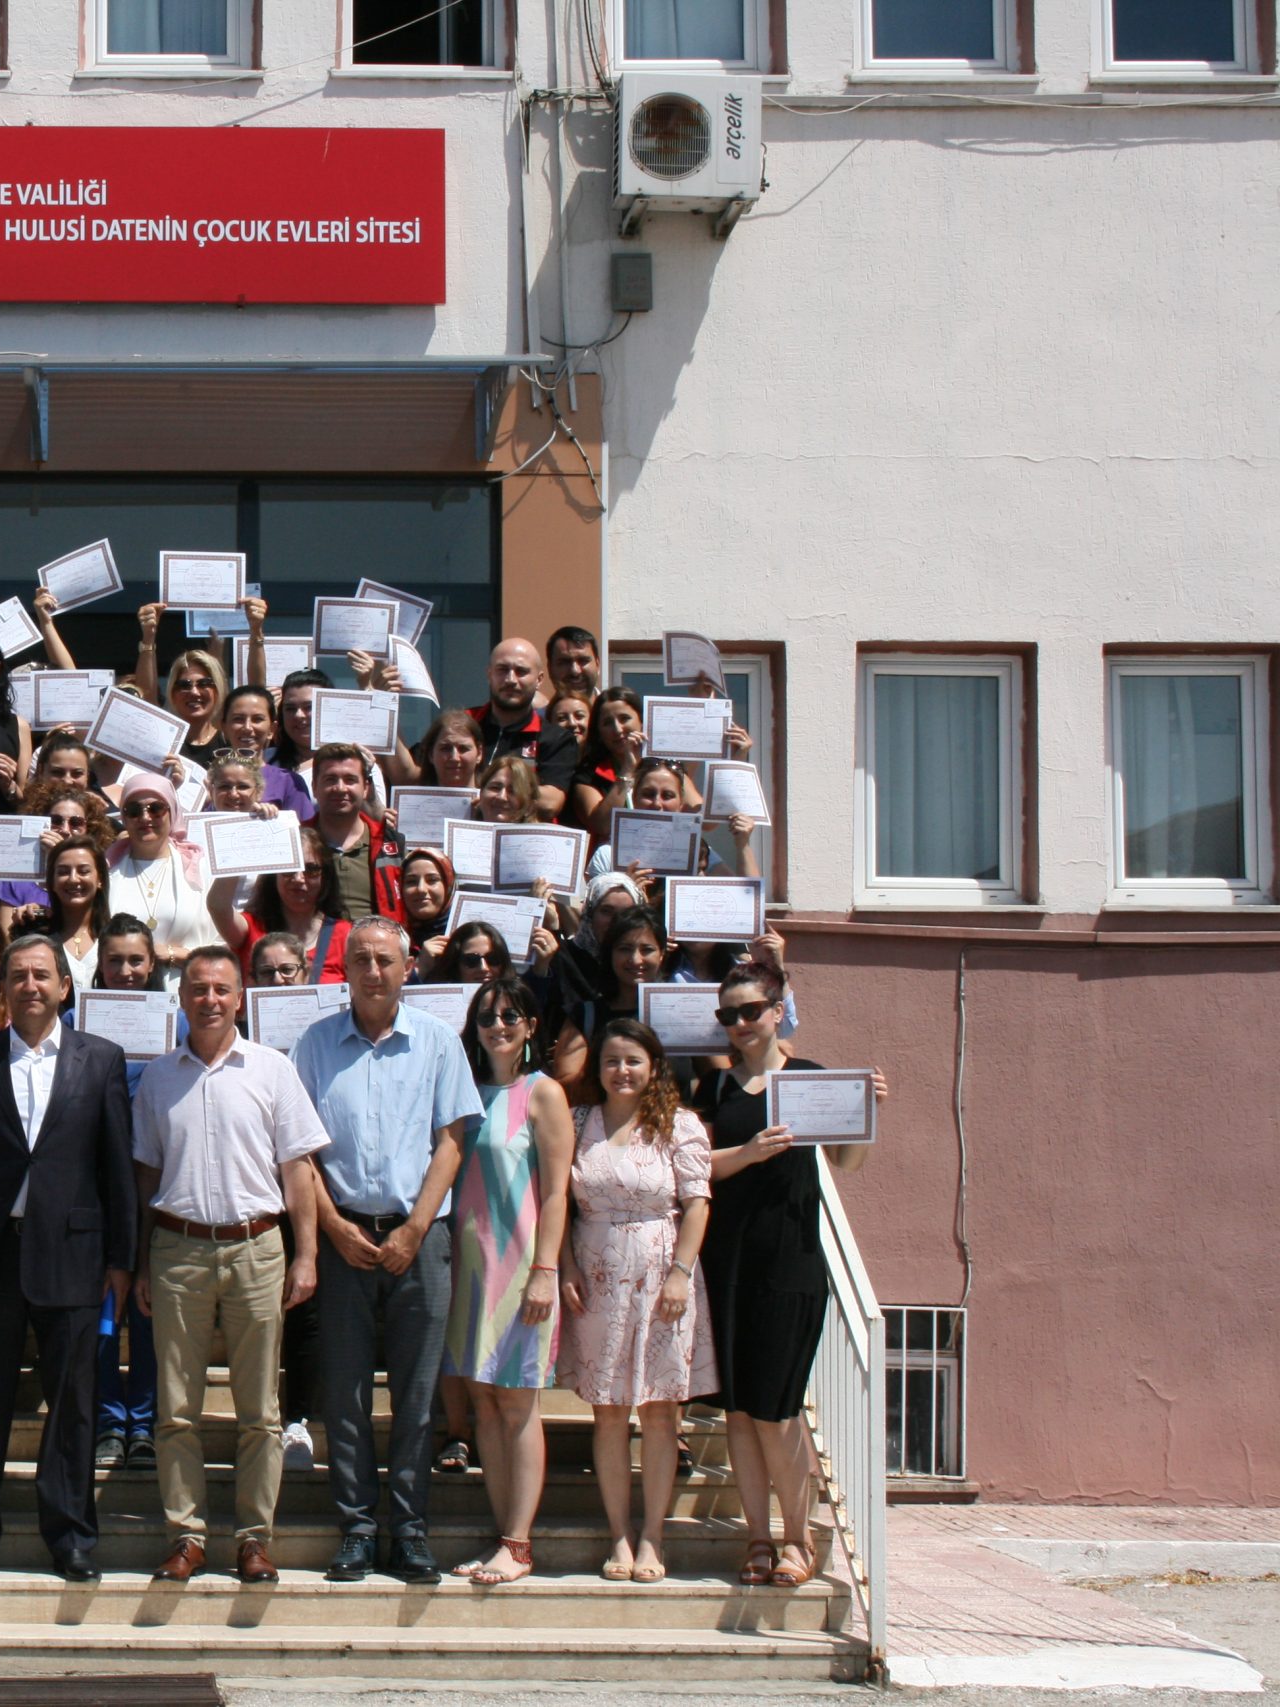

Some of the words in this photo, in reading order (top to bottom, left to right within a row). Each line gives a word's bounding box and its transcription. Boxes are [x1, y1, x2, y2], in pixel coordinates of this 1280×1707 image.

[724, 93, 745, 160] arçelik
[15, 179, 107, 206] VALİLİĞİ
[5, 215, 86, 242] HULUSİ
[91, 215, 188, 242] DATENİN
[193, 219, 272, 248] ÇOCUK
[276, 216, 350, 243] EVLERİ
[355, 216, 420, 244] SİTESİ
